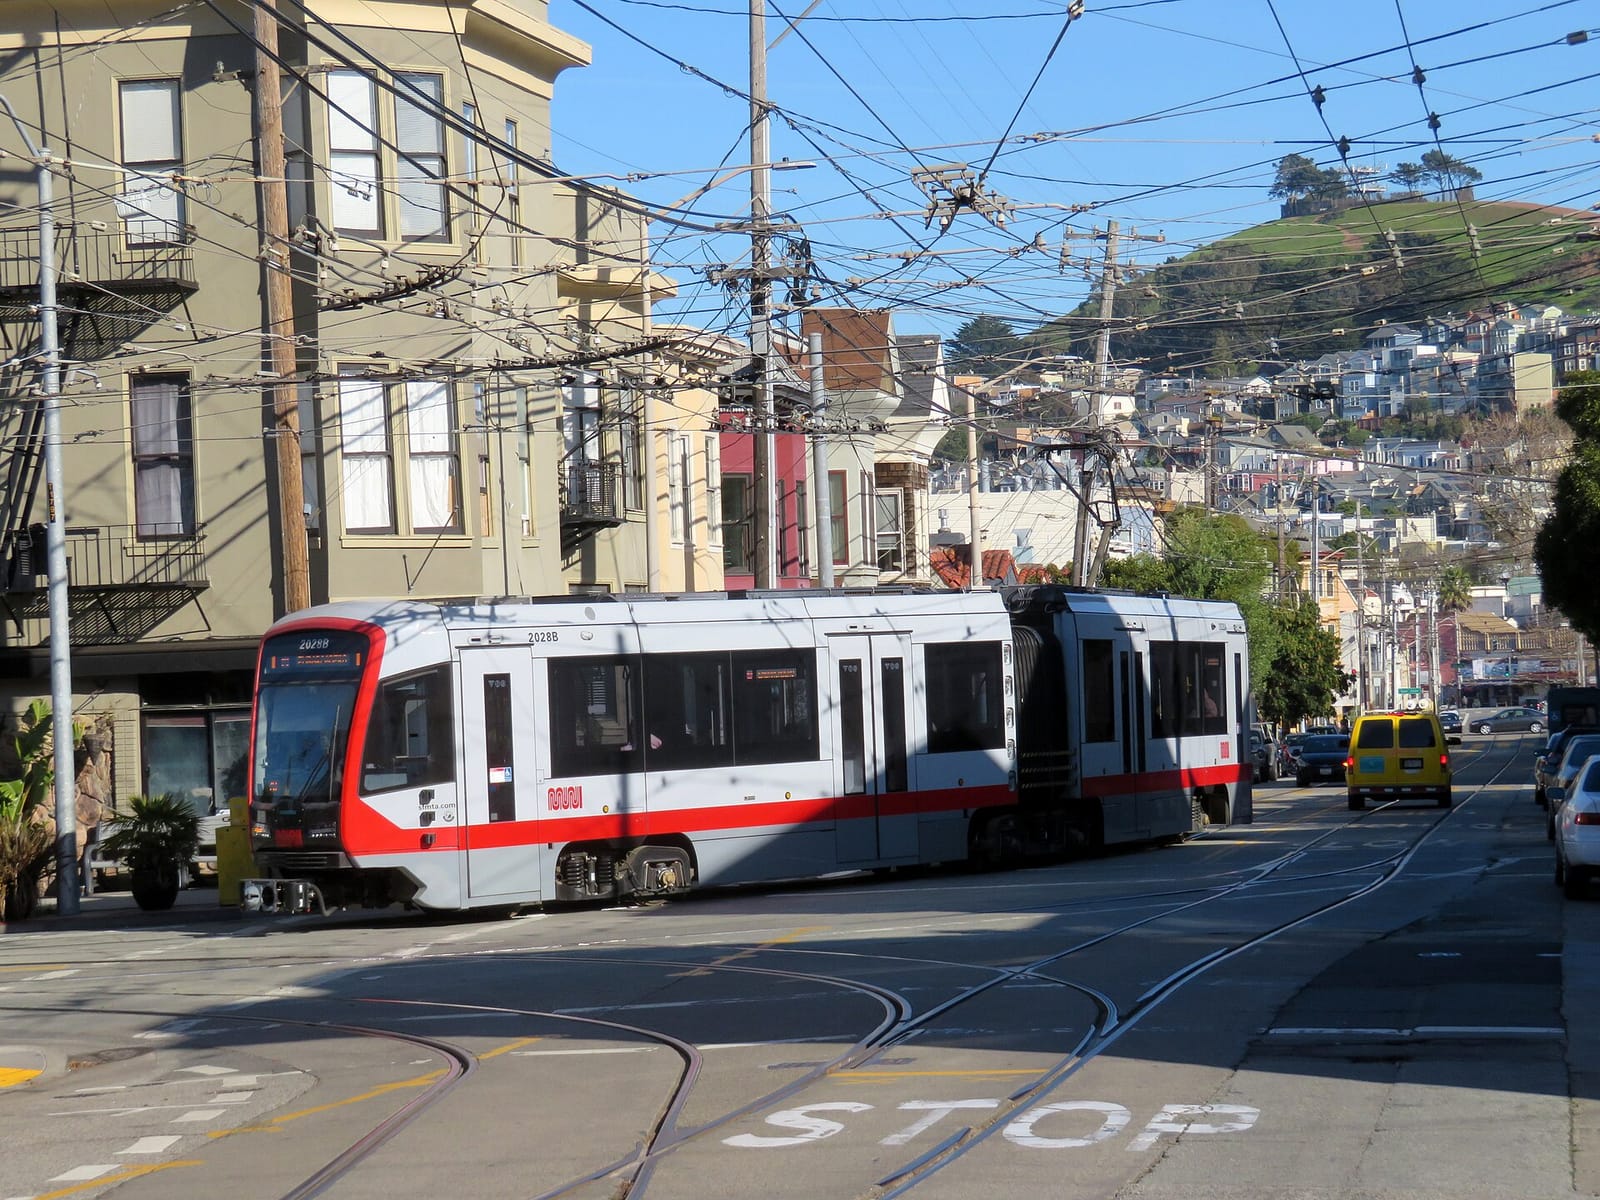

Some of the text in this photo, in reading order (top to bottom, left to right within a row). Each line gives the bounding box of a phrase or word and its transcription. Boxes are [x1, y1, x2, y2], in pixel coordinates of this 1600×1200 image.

[528, 631, 559, 643] 2028B
[299, 638, 330, 650] 2028B
[721, 1097, 1261, 1152] STOP
